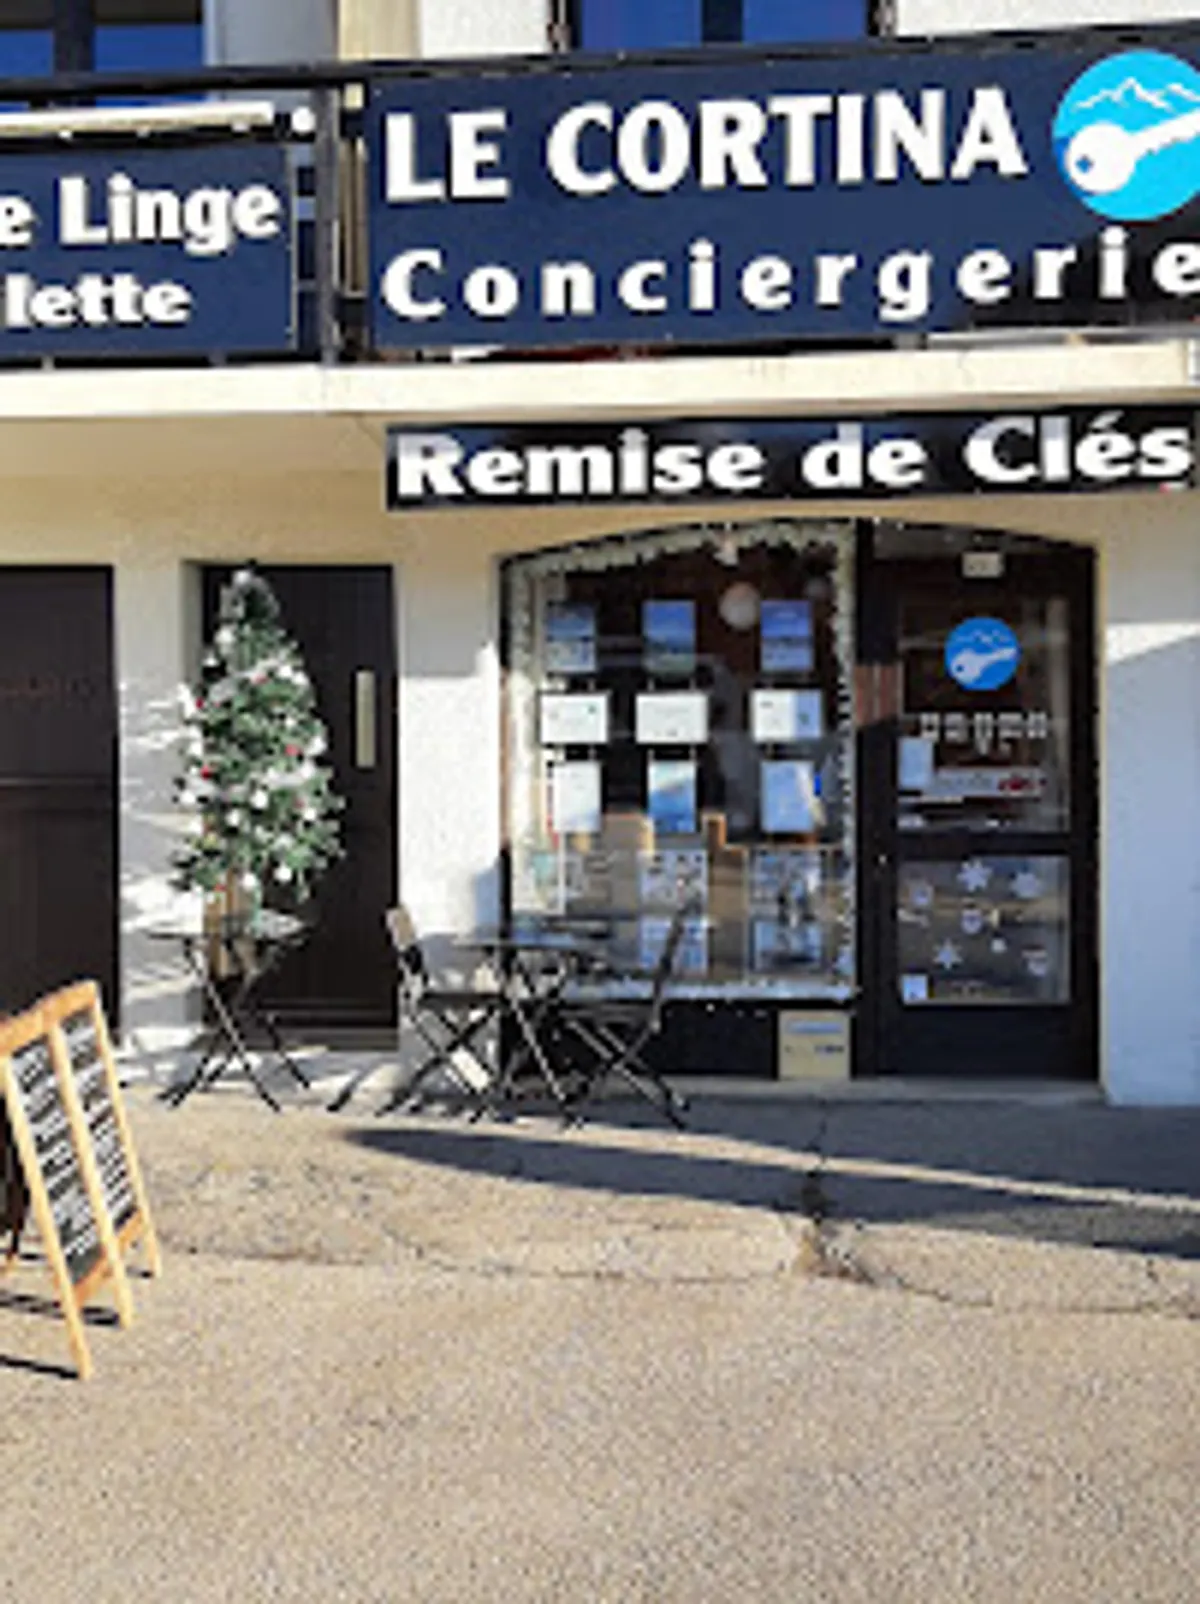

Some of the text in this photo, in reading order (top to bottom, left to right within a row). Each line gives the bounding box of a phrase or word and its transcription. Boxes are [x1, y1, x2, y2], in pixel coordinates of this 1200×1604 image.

[386, 87, 1029, 201] LE CORTINA
[59, 172, 281, 257] Linge
[381, 226, 1200, 322] Conciergerie
[396, 413, 1195, 497] Remise de Clés
